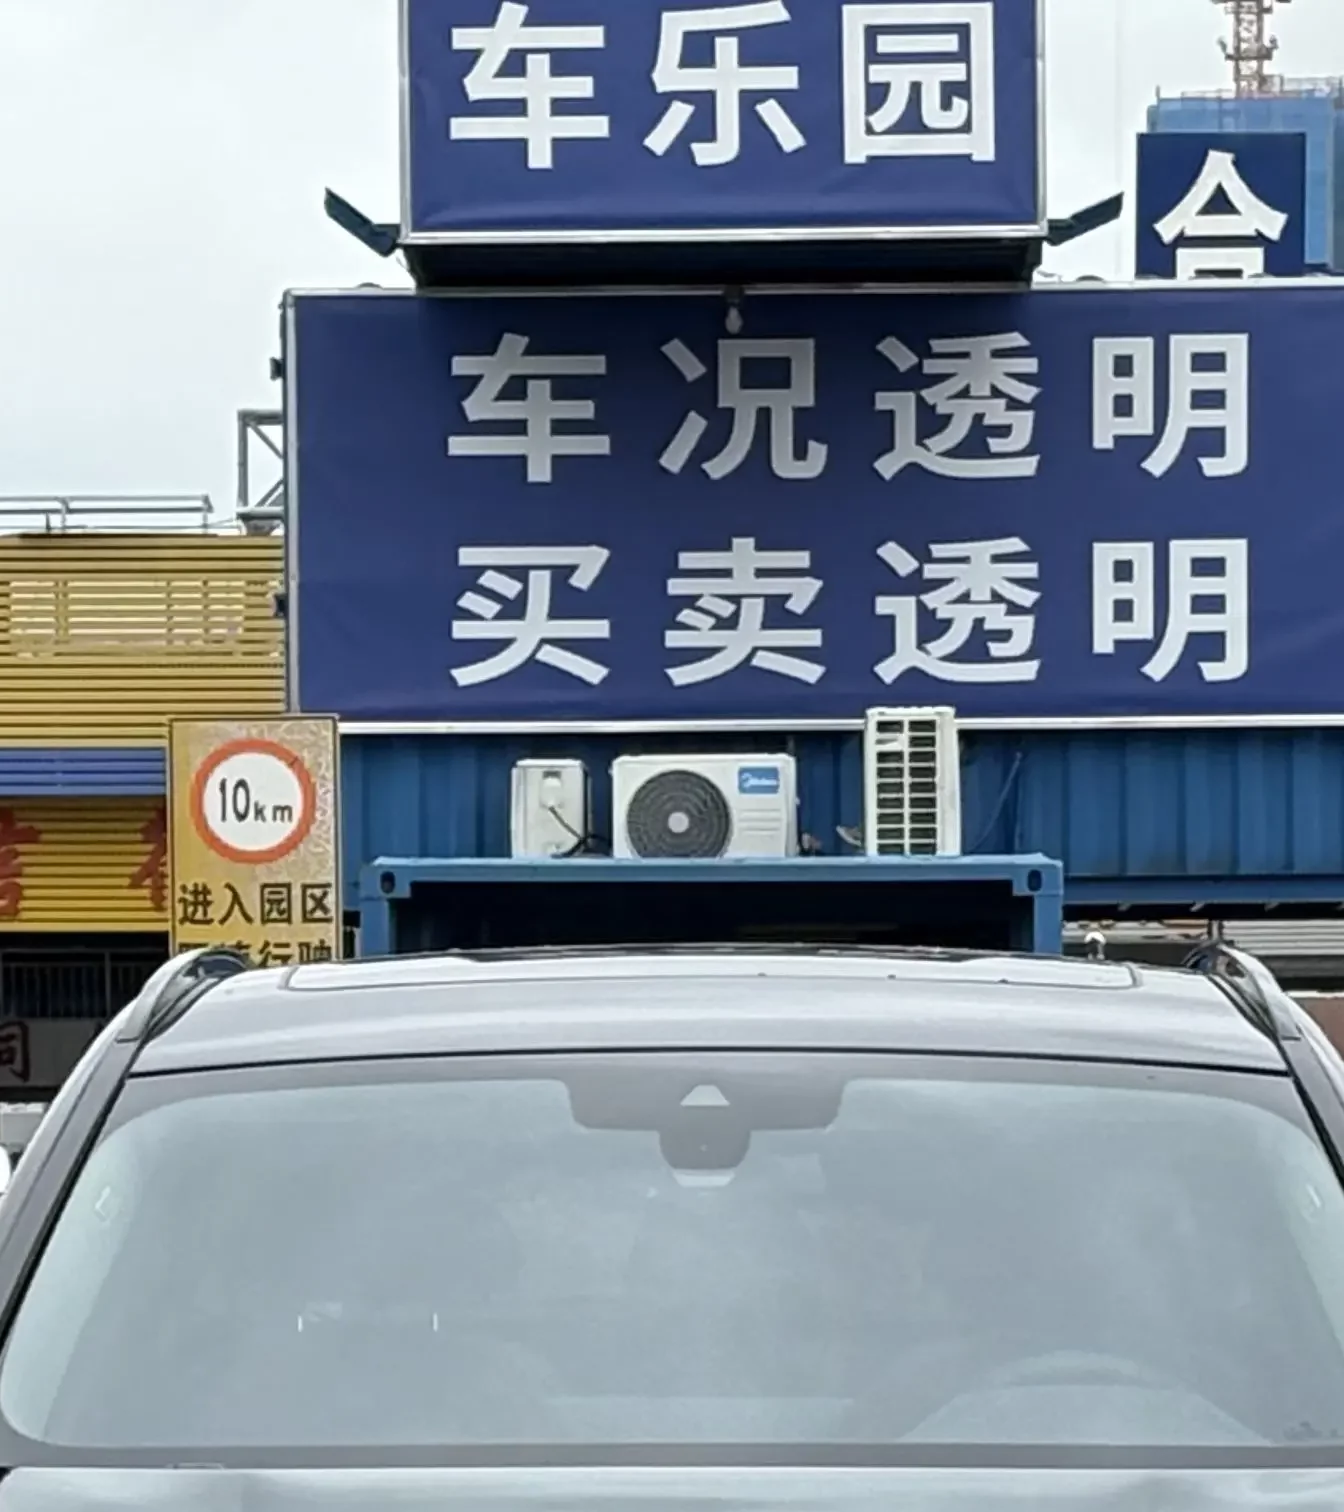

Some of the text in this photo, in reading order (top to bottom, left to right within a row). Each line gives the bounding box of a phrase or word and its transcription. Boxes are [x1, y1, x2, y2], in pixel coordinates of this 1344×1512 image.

[448, 0, 997, 170] 车乐园
[447, 331, 1250, 484] 车况透明
[448, 536, 1250, 687] 买卖透明
[219, 778, 293, 823] 10km
[178, 882, 334, 926] 进入园区
